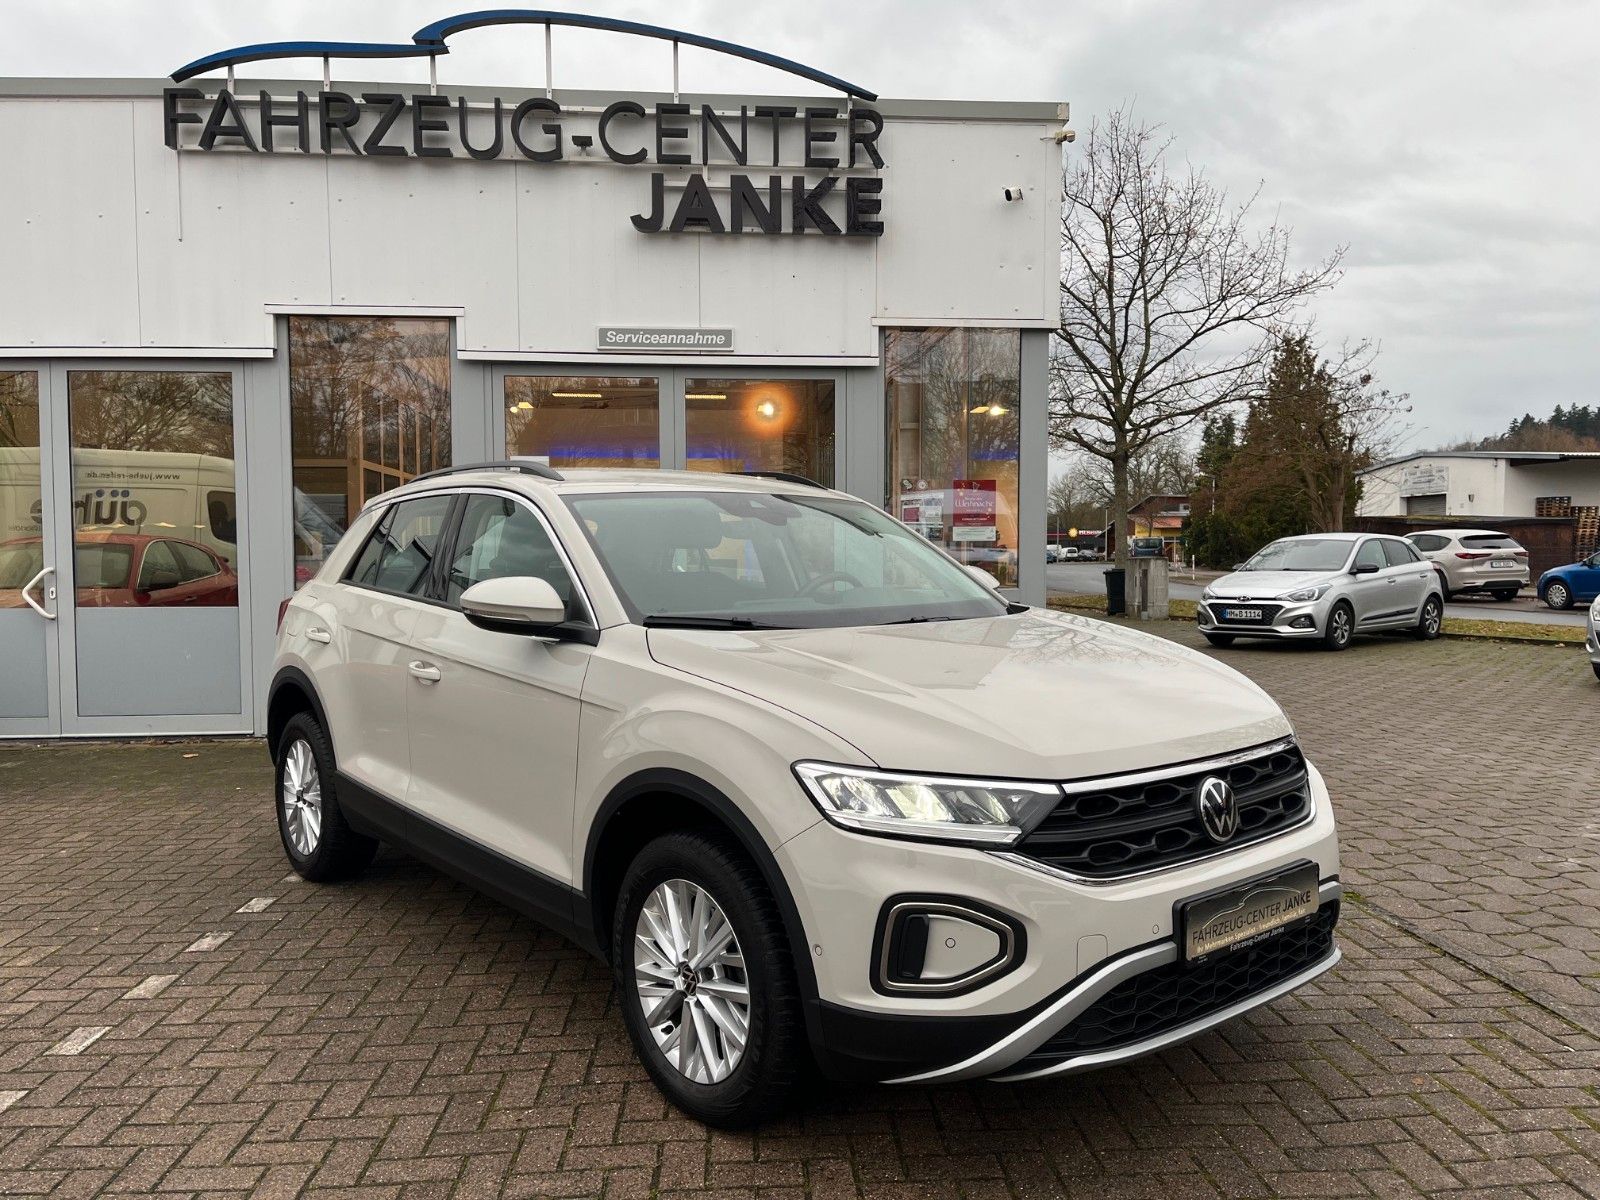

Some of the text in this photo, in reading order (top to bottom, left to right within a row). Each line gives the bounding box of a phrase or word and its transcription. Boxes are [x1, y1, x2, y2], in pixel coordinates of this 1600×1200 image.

[164, 88, 885, 169] FAHRZEUG-CENTER
[630, 172, 885, 236] JANKE
[605, 330, 726, 348] Serviceannahme
[1192, 890, 1311, 945] FAHRZEUG-CENTER JANKE
